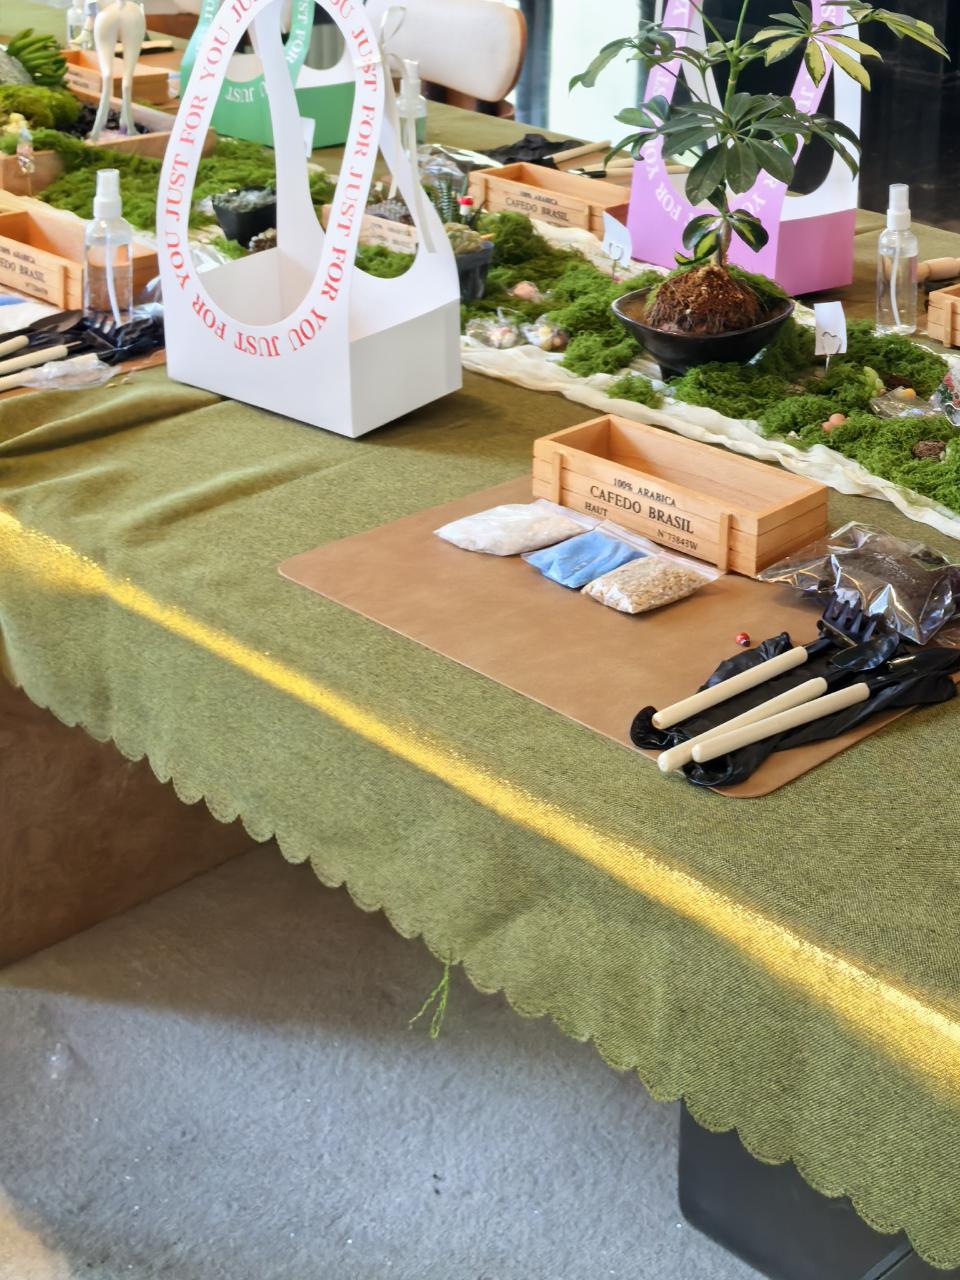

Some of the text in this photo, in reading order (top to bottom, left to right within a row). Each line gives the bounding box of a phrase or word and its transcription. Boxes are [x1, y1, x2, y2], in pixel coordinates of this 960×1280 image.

[200, 26, 231, 83] YOU
[225, 87, 255, 103] JUST
[179, 95, 207, 146] FOR
[353, 105, 376, 156] FOR
[165, 153, 189, 222] JUST
[337, 165, 363, 237] JUST
[656, 183, 682, 221] FOR
[166, 231, 191, 289] YOU
[320, 246, 346, 301] FOR
[192, 293, 227, 341] FOR
[287, 308, 328, 352] YOU
[234, 331, 281, 357] JUST
[584, 501, 609, 517] HAUT
[590, 485, 694, 534] CAFEDO BRASIL
[613, 478, 677, 507] 100% ARABICA
